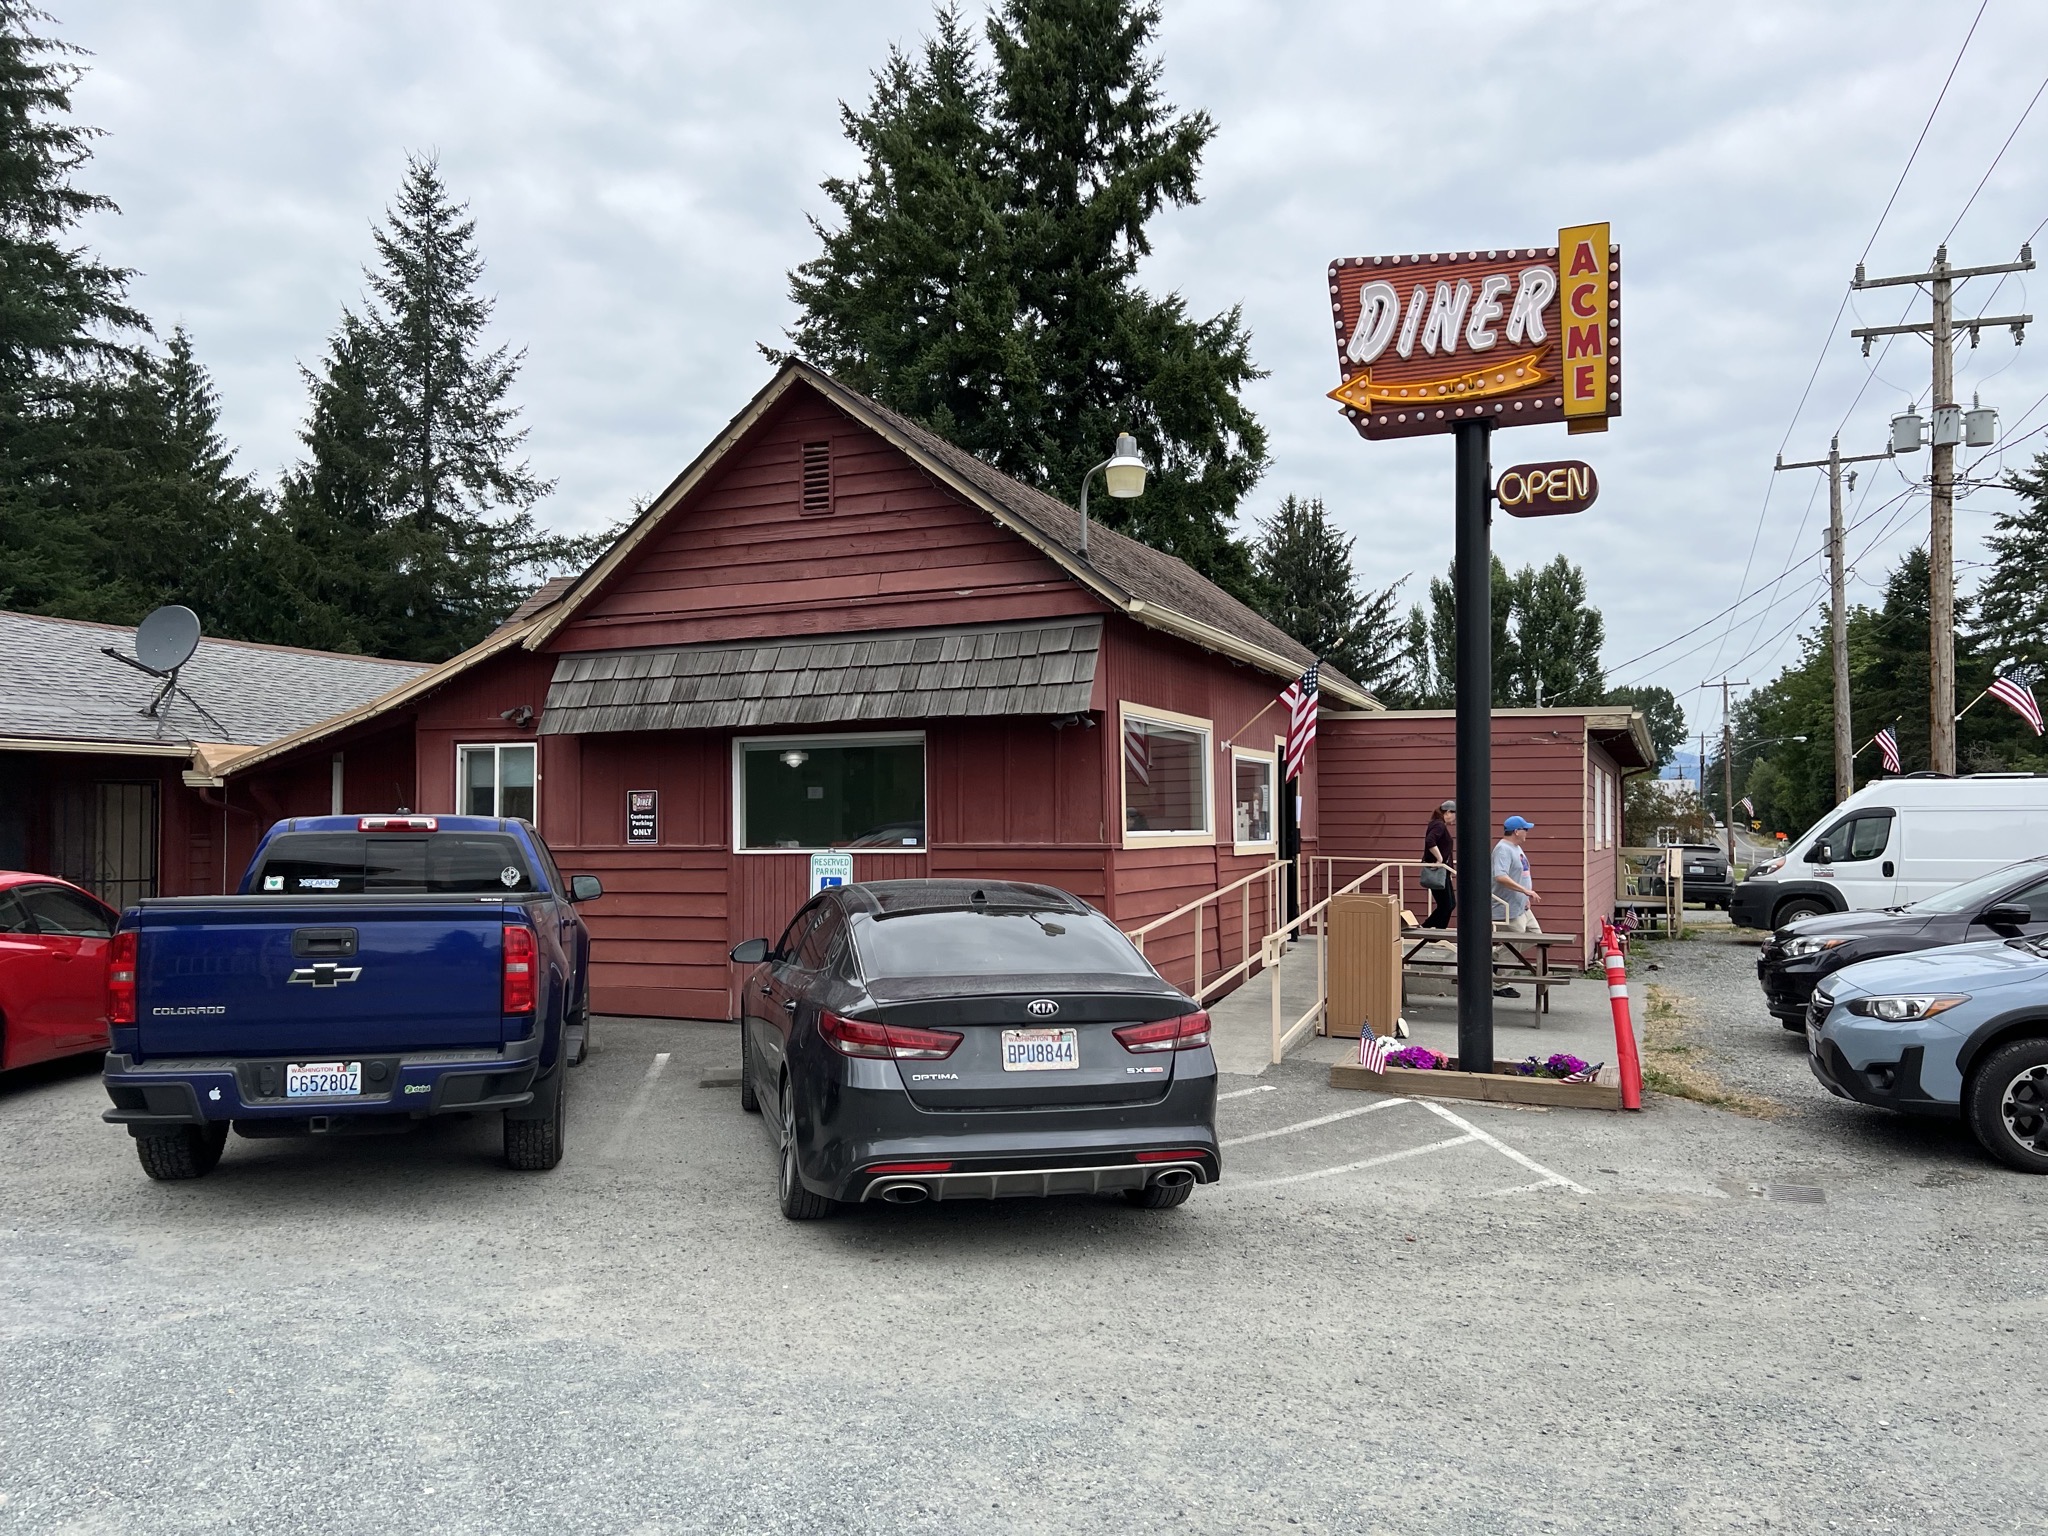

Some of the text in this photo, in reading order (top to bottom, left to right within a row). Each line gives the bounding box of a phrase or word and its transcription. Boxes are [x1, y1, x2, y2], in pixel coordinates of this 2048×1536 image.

[1346, 264, 1557, 365] DINER
[1566, 240, 1603, 401] ACME
[1499, 466, 1590, 505] OPEN
[632, 828, 652, 836] ONLY
[814, 858, 849, 866] RESERVED
[815, 867, 848, 876] PARKING
[152, 1006, 226, 1016] COLORADO
[1032, 1003, 1055, 1014] KIA
[1008, 1043, 1073, 1063] BPU8844
[912, 1073, 959, 1081] OPTIMA
[290, 1073, 358, 1093] C65280Z
